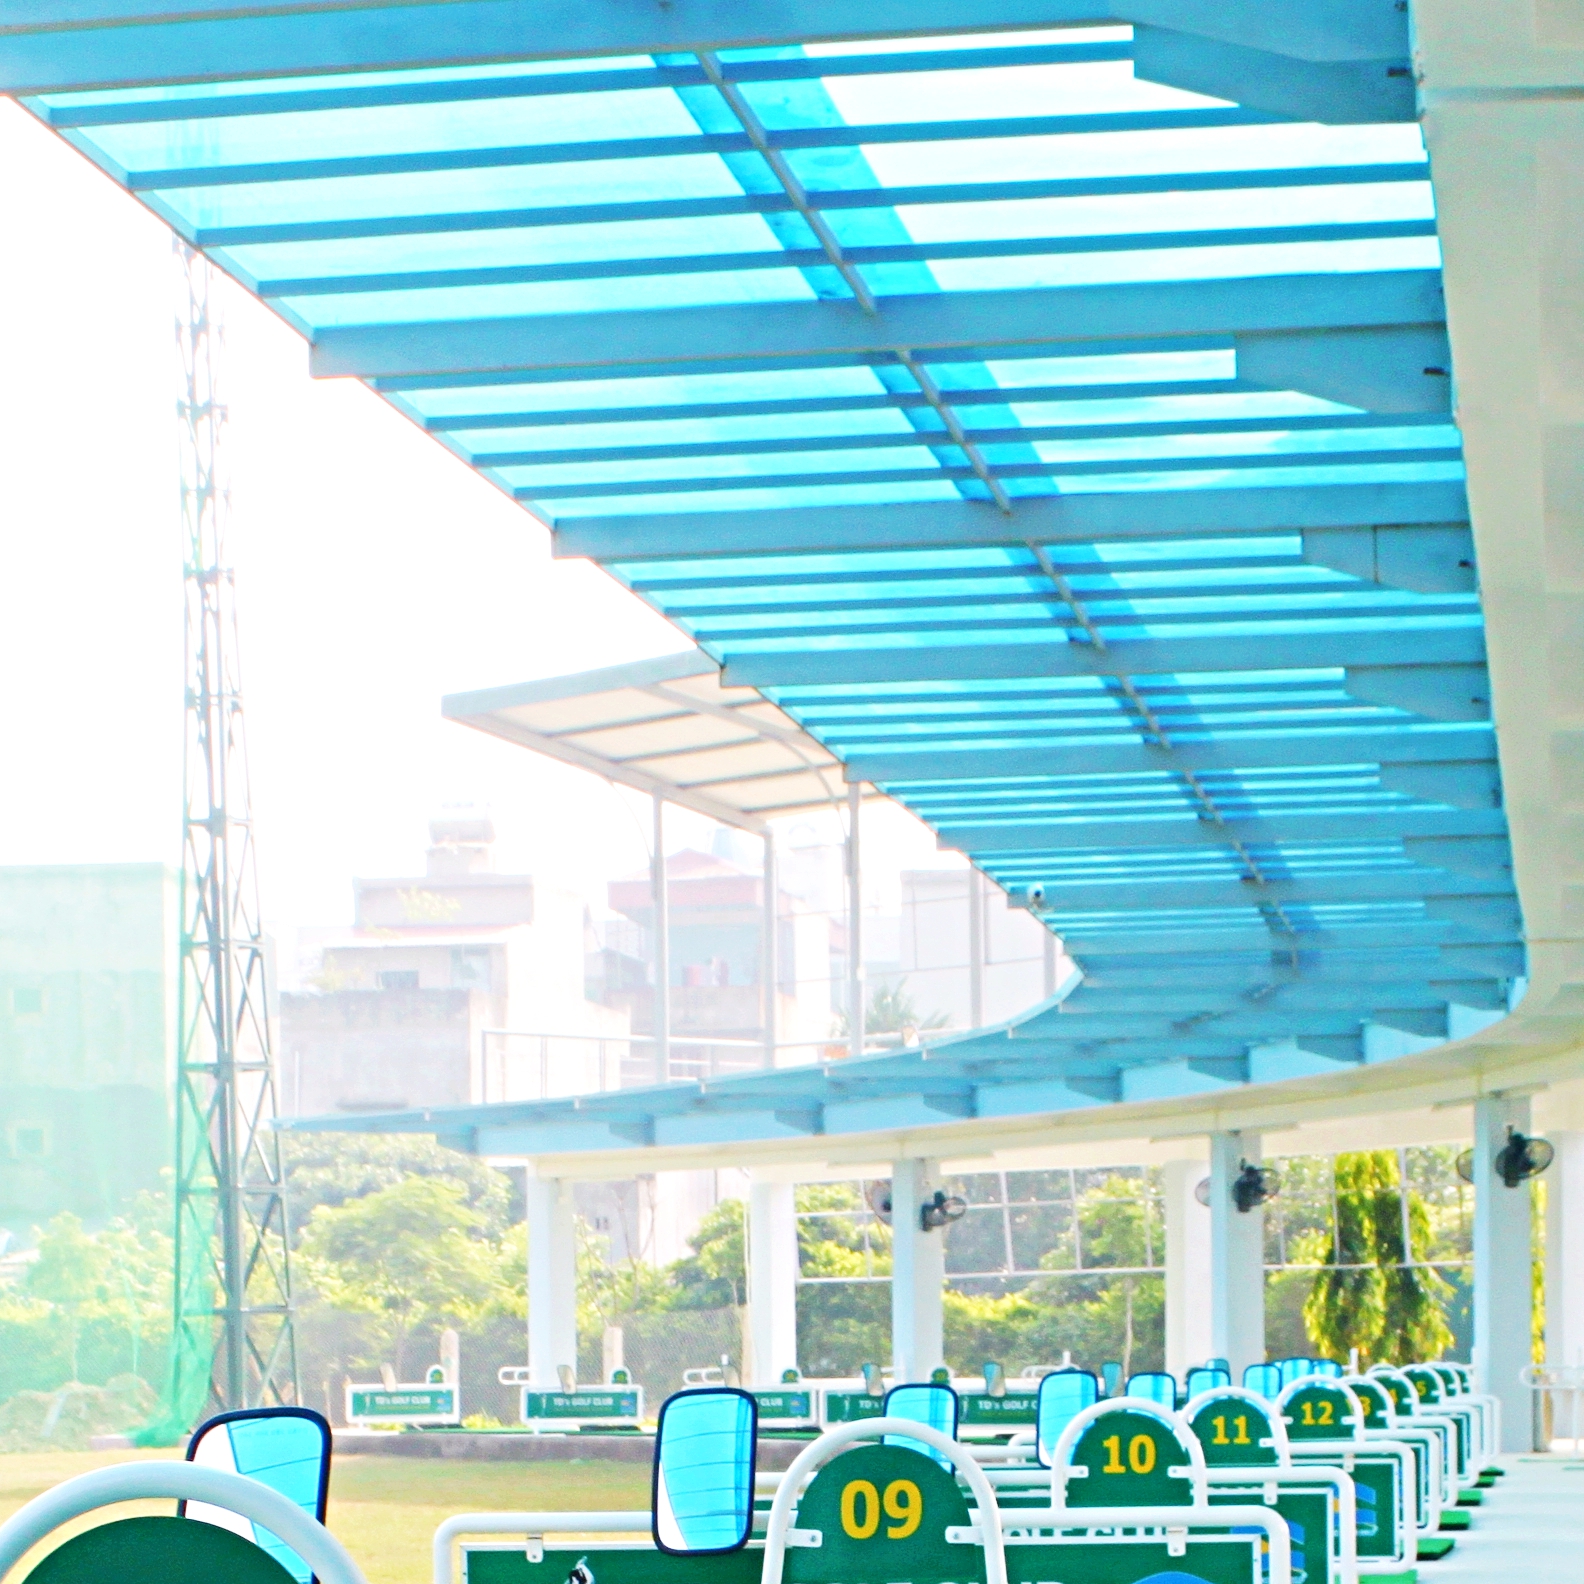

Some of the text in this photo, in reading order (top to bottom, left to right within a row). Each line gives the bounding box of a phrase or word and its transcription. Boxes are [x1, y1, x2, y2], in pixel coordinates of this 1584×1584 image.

[1211, 1416, 1251, 1445] 11
[1300, 1402, 1334, 1425] 12
[1102, 1434, 1156, 1474] 10
[840, 1479, 923, 1540] 09
